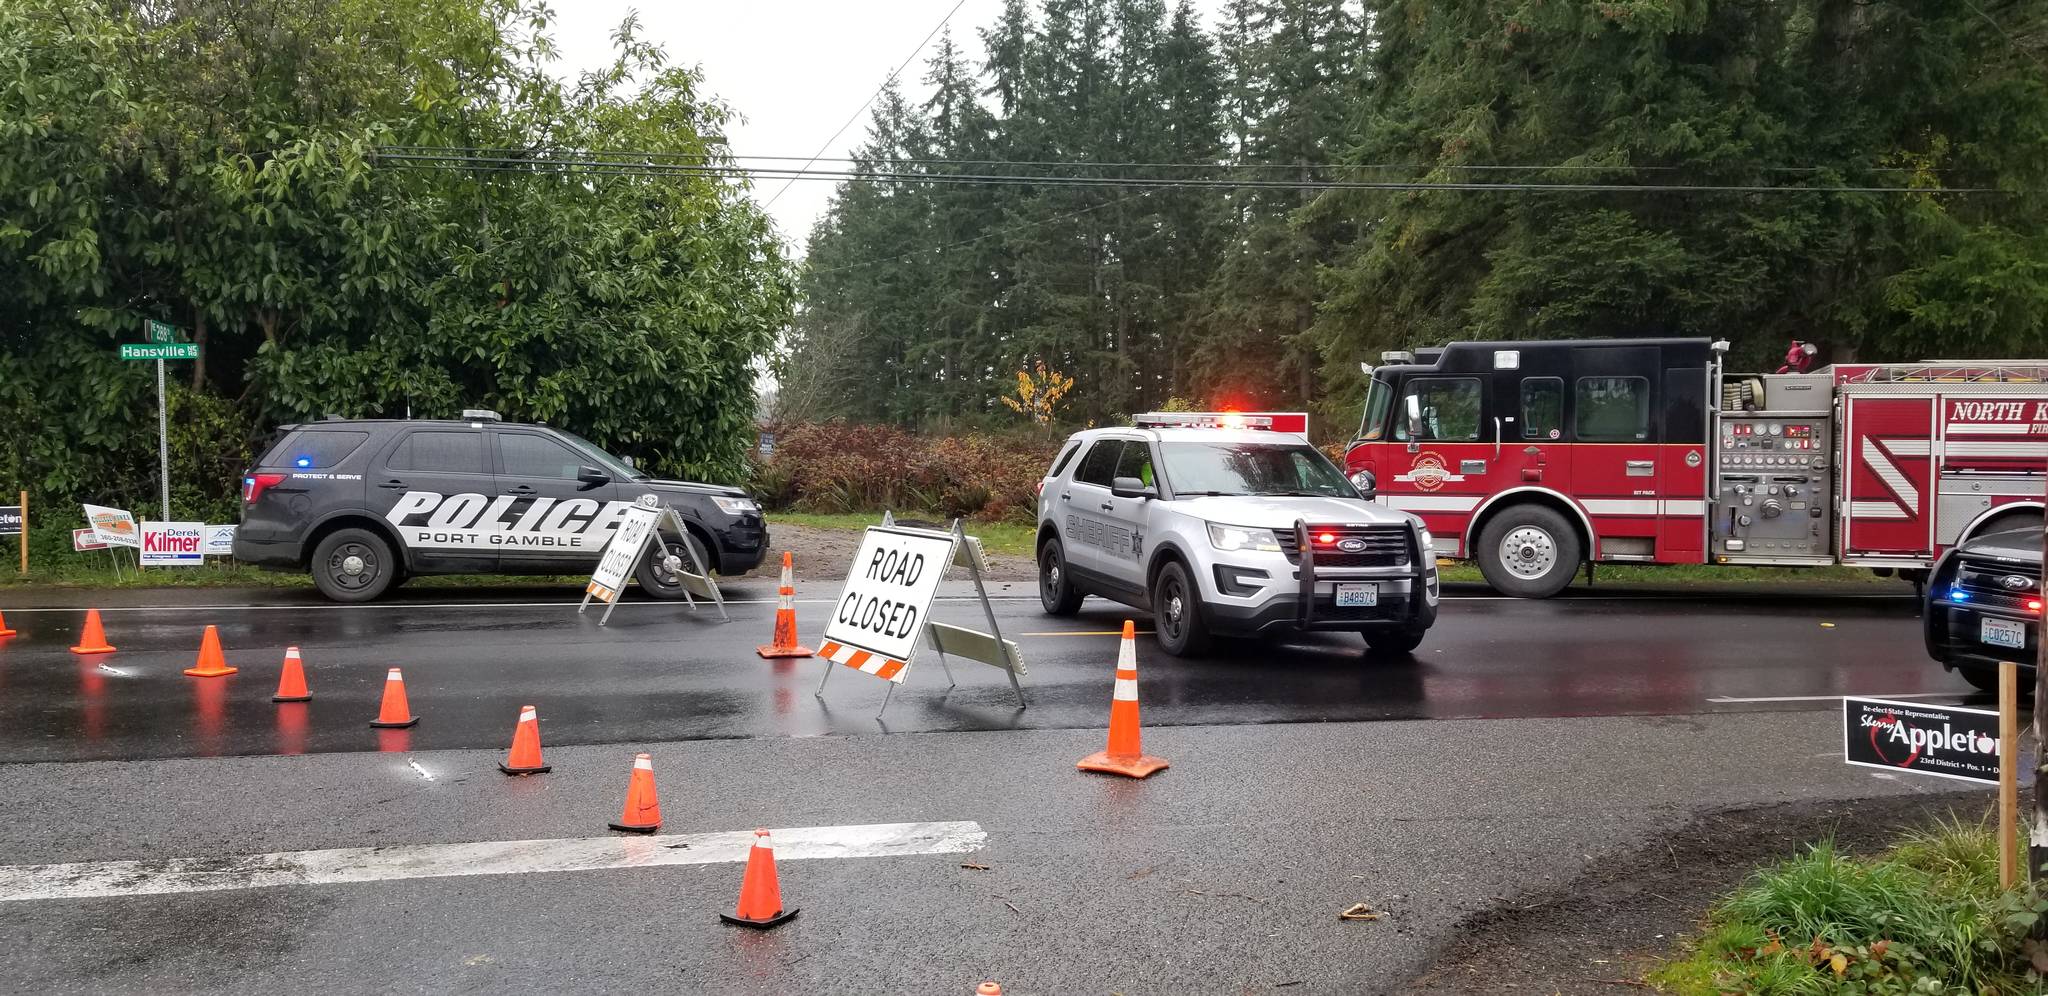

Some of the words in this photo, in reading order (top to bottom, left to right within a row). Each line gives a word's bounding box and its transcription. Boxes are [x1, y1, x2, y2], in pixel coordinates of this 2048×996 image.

[122, 346, 185, 357] Hansville
[1950, 402, 2026, 421] NORTH
[385, 491, 636, 535] POLICE
[167, 528, 200, 537] Derek
[418, 532, 480, 545] PORT
[489, 534, 582, 547] GAMBLE
[1066, 514, 1130, 553] SHERIFF
[144, 531, 200, 552] Kilmer
[866, 547, 924, 587] ROAD
[2005, 577, 2024, 588] Ford
[1344, 591, 1375, 603] B4897C
[839, 592, 917, 639] CLOSED
[1988, 627, 2022, 644] C0257C
[1863, 705, 1888, 714] Re-elect
[1888, 708, 1904, 716] State
[1905, 709, 1950, 720] Representative
[1860, 714, 1895, 734] Sherry
[1920, 757, 1935, 765] 23rd
[1936, 759, 1960, 768] District
[1966, 763, 1980, 771] Pos.
